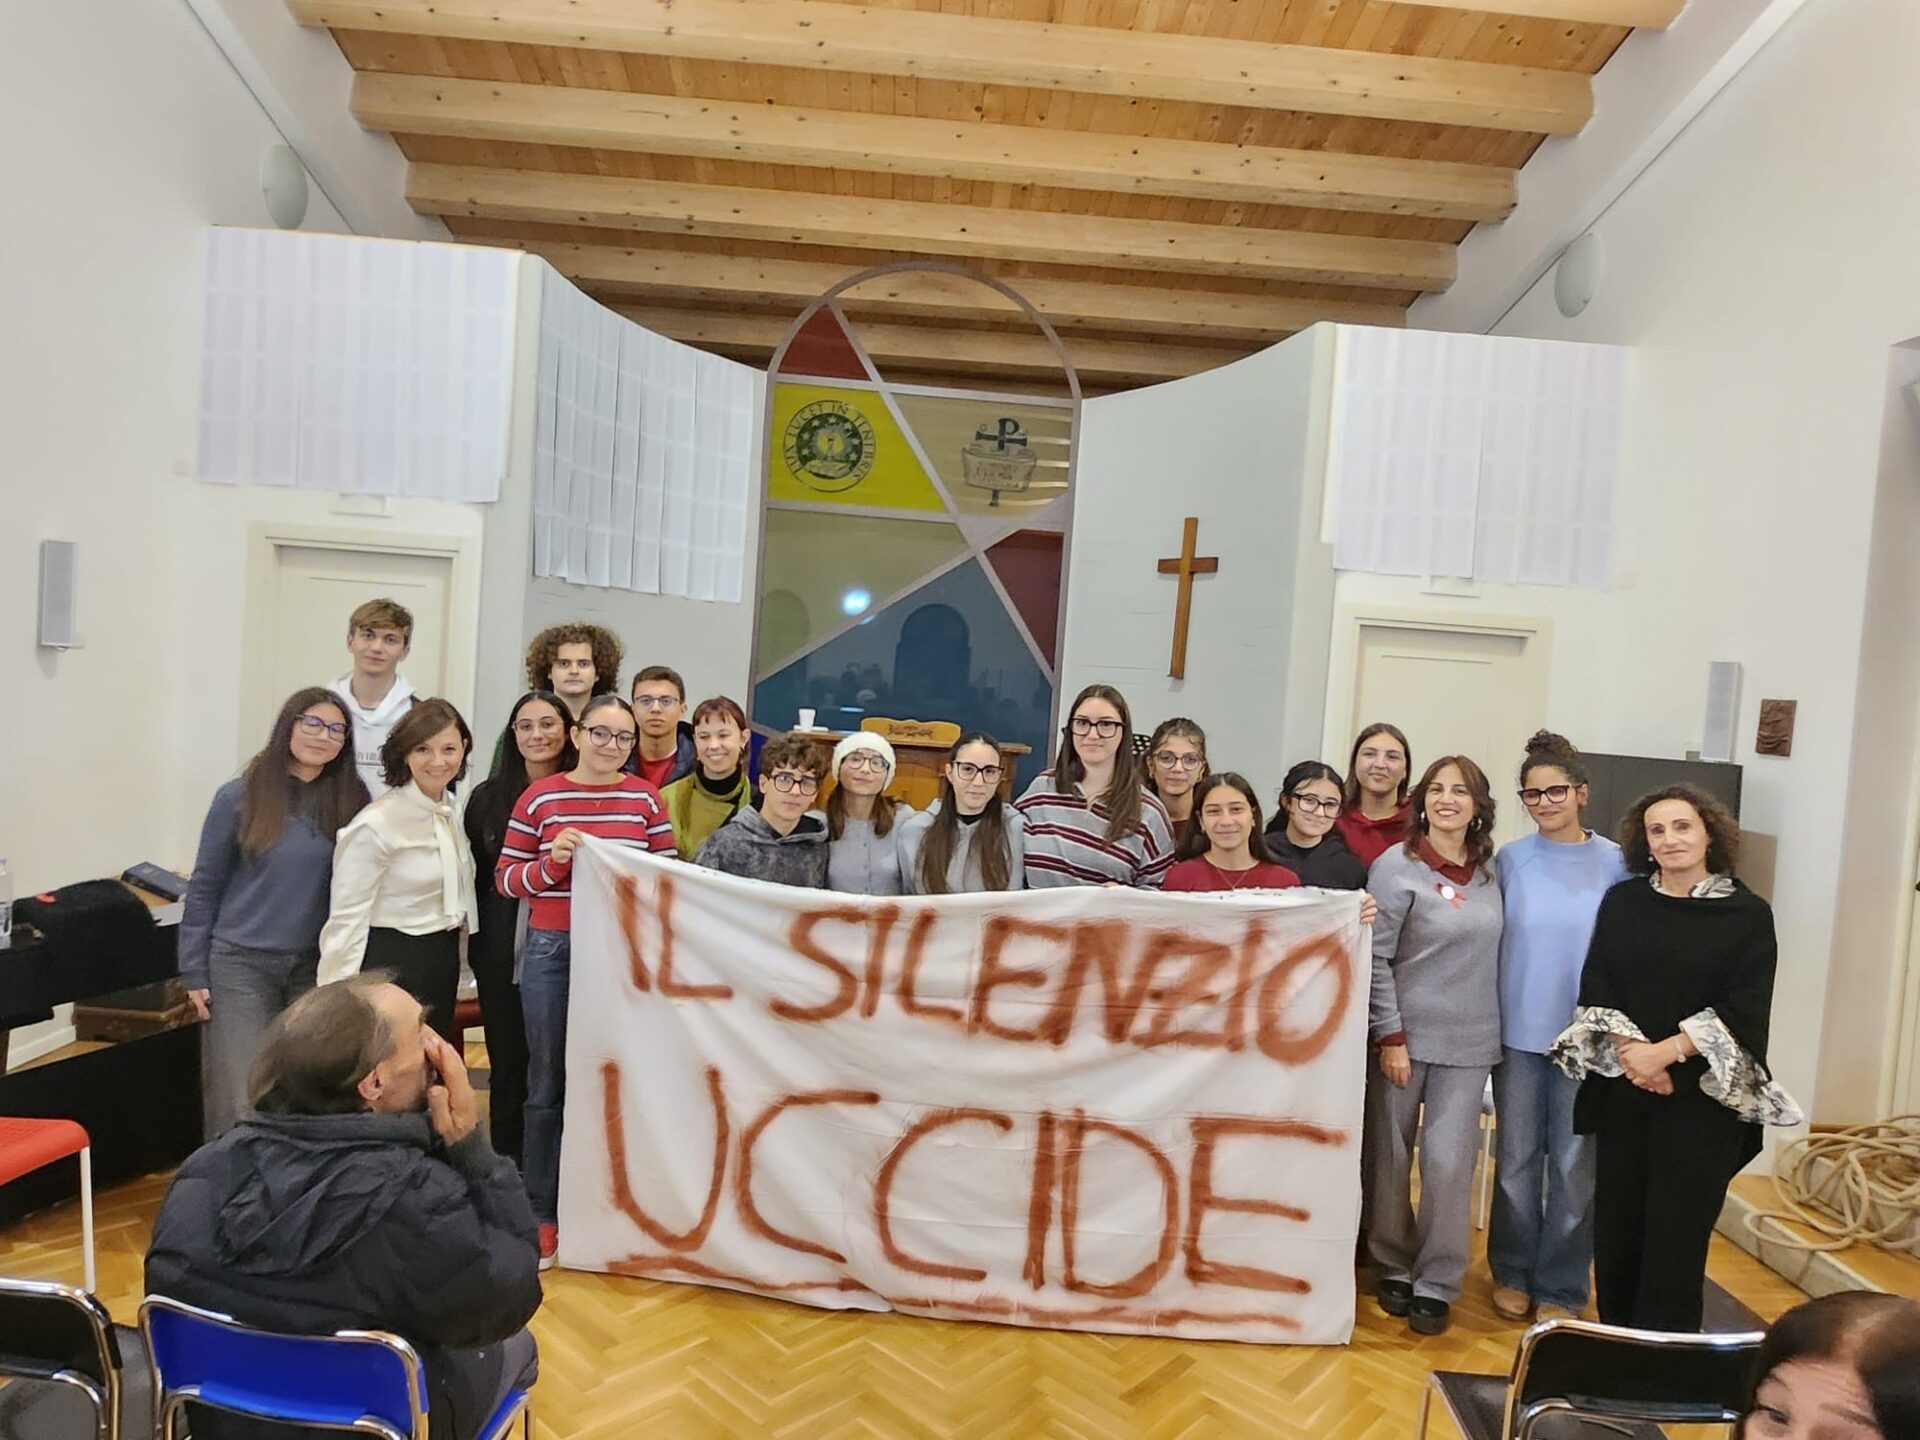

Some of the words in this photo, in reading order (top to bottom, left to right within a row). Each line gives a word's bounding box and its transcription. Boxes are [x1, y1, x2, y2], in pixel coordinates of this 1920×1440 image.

[831, 403, 849, 415] IN
[612, 870, 734, 1000] IL
[769, 903, 1355, 1067] SILENZIO
[600, 1059, 1348, 1300] UCCIDE
